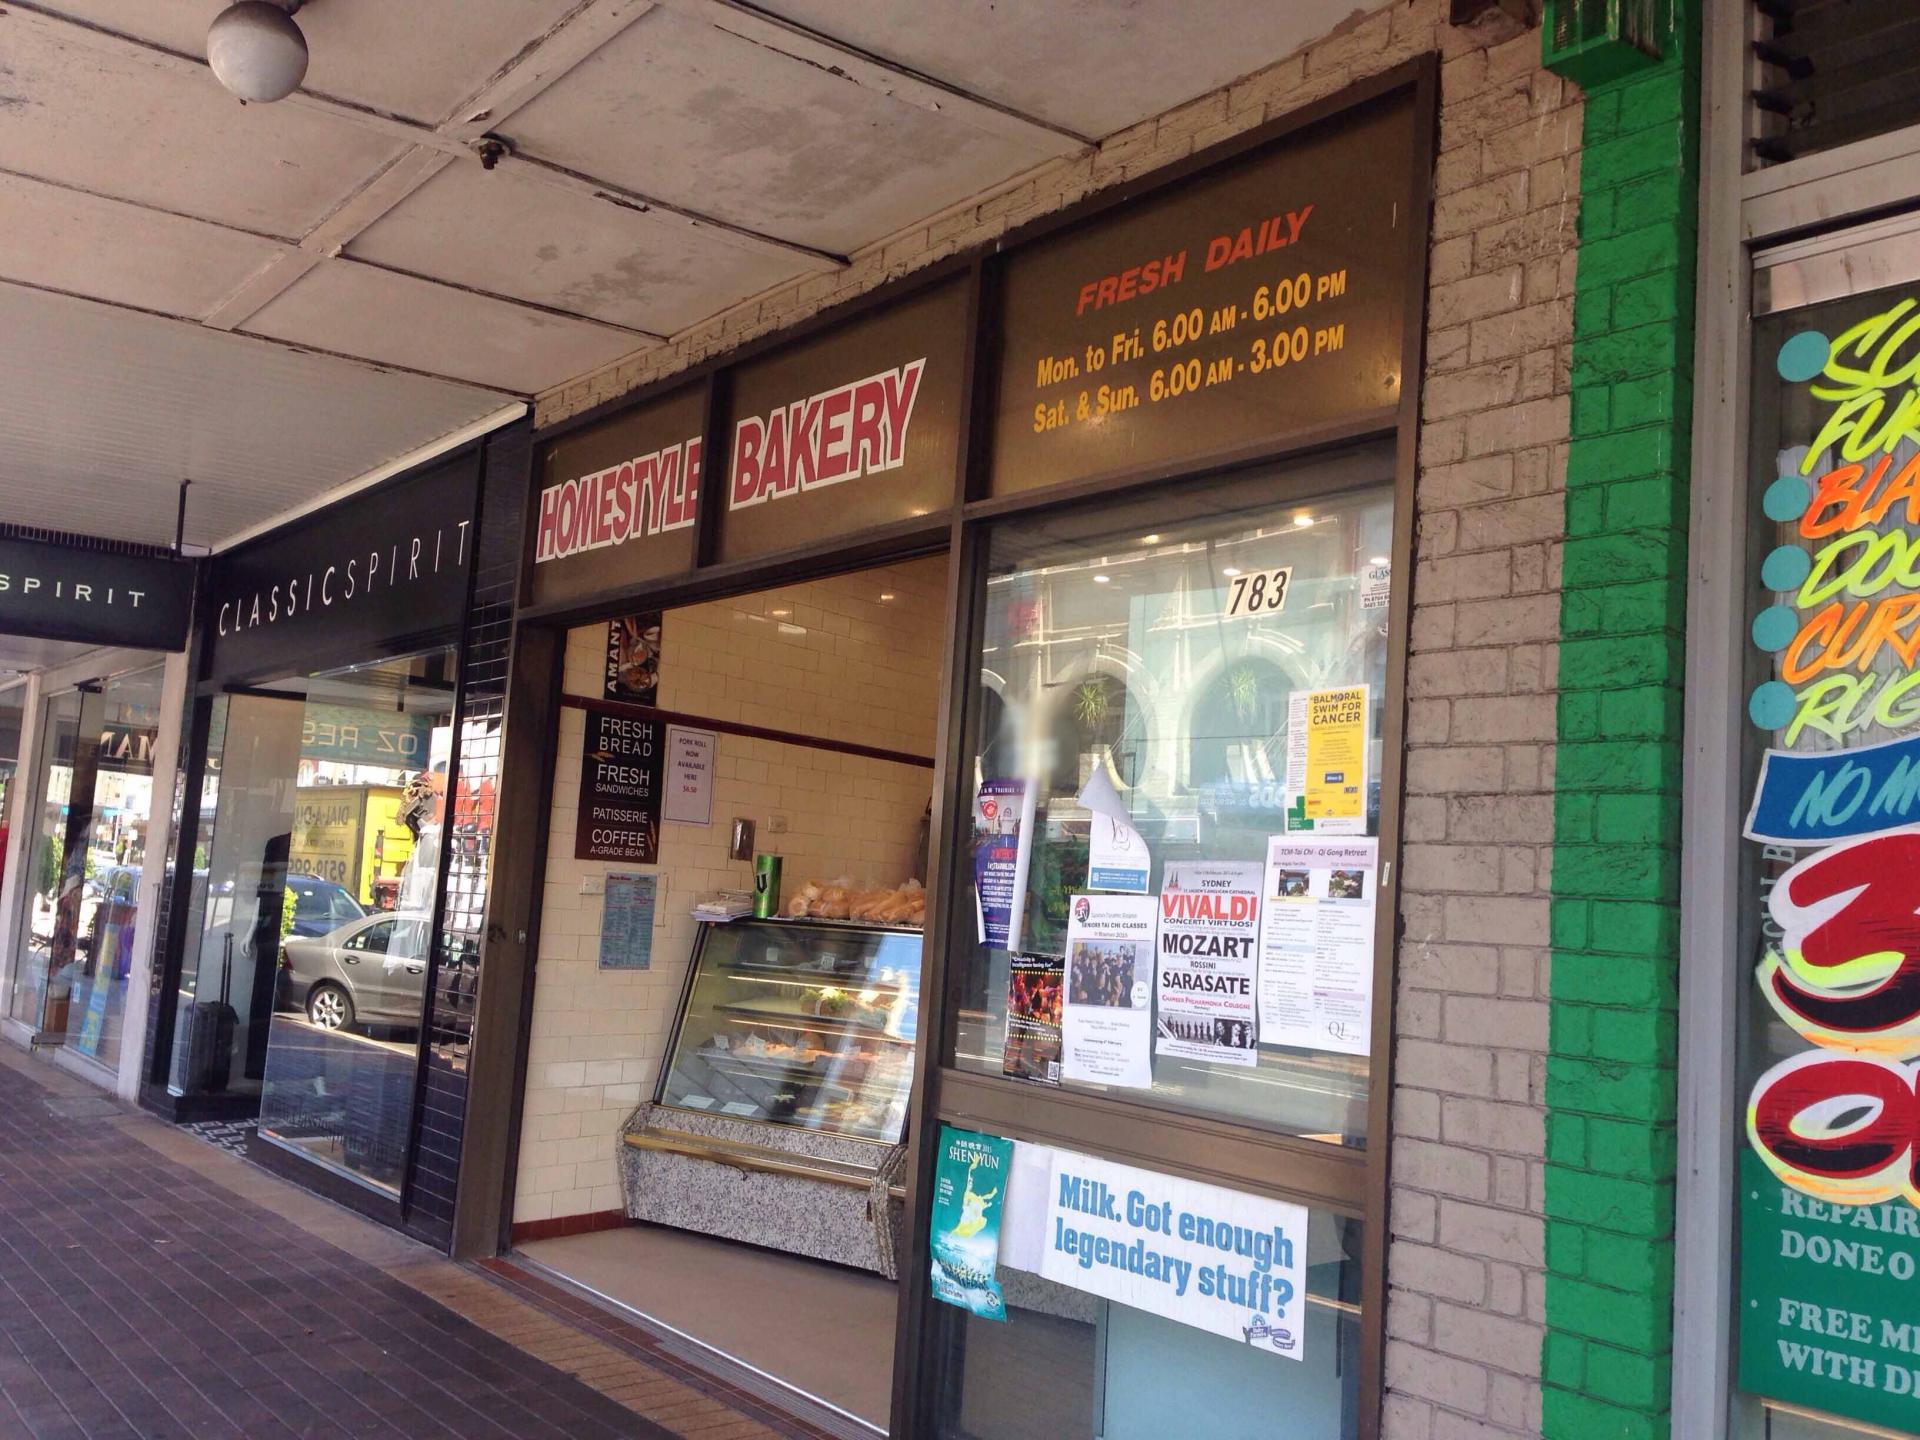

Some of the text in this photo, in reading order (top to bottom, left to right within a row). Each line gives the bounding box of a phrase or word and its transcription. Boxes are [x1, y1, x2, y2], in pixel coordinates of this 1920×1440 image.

[1075, 204, 1315, 316] FRESH DAILY
[1036, 355, 1079, 388] Mon.
[1086, 344, 1105, 373] to
[1111, 327, 1145, 366] Fri.
[1152, 307, 1204, 353] 6.00
[1209, 304, 1237, 336] AM
[1252, 272, 1312, 321] 6.00
[1316, 269, 1348, 302] PM
[1033, 400, 1069, 433] Sat.
[1095, 384, 1139, 418] Sun.
[1149, 358, 1201, 402] 6.00
[1205, 357, 1233, 387] AM
[1250, 326, 1309, 375] 3.00
[1313, 323, 1346, 356] PM
[536, 357, 927, 563] HOMESTYLE BAKERY
[1229, 570, 1288, 616] 783
[1313, 690, 1361, 704] BALMORAL
[1313, 701, 1361, 714] SWIM FOR
[601, 717, 653, 740] FRESH
[1313, 712, 1361, 725] CANCER
[600, 736, 652, 757] BREAD
[597, 764, 650, 786] FRESH
[595, 783, 649, 797] SANDWICHES
[593, 807, 648, 824] PATISSERIE
[591, 828, 645, 847] COFFEE
[590, 846, 645, 857] A-GRADE BEAN
[1201, 880, 1232, 888] SYDNEY
[1162, 894, 1257, 922] VIVALDI
[1163, 918, 1253, 928] CONCERTI VIRTUOSI
[1162, 933, 1255, 959] MOZART
[1190, 961, 1217, 970] ROSSINI
[1162, 971, 1251, 996] SARASATE
[949, 1145, 1000, 1170] SHEN YUN
[1059, 1173, 1294, 1273] Milk. Got enough
[1780, 1229, 1885, 1276] DONE
[1054, 1216, 1294, 1319] legendary stuff?
[1778, 1297, 1873, 1345] FREE
[1777, 1339, 1876, 1388] WITH
